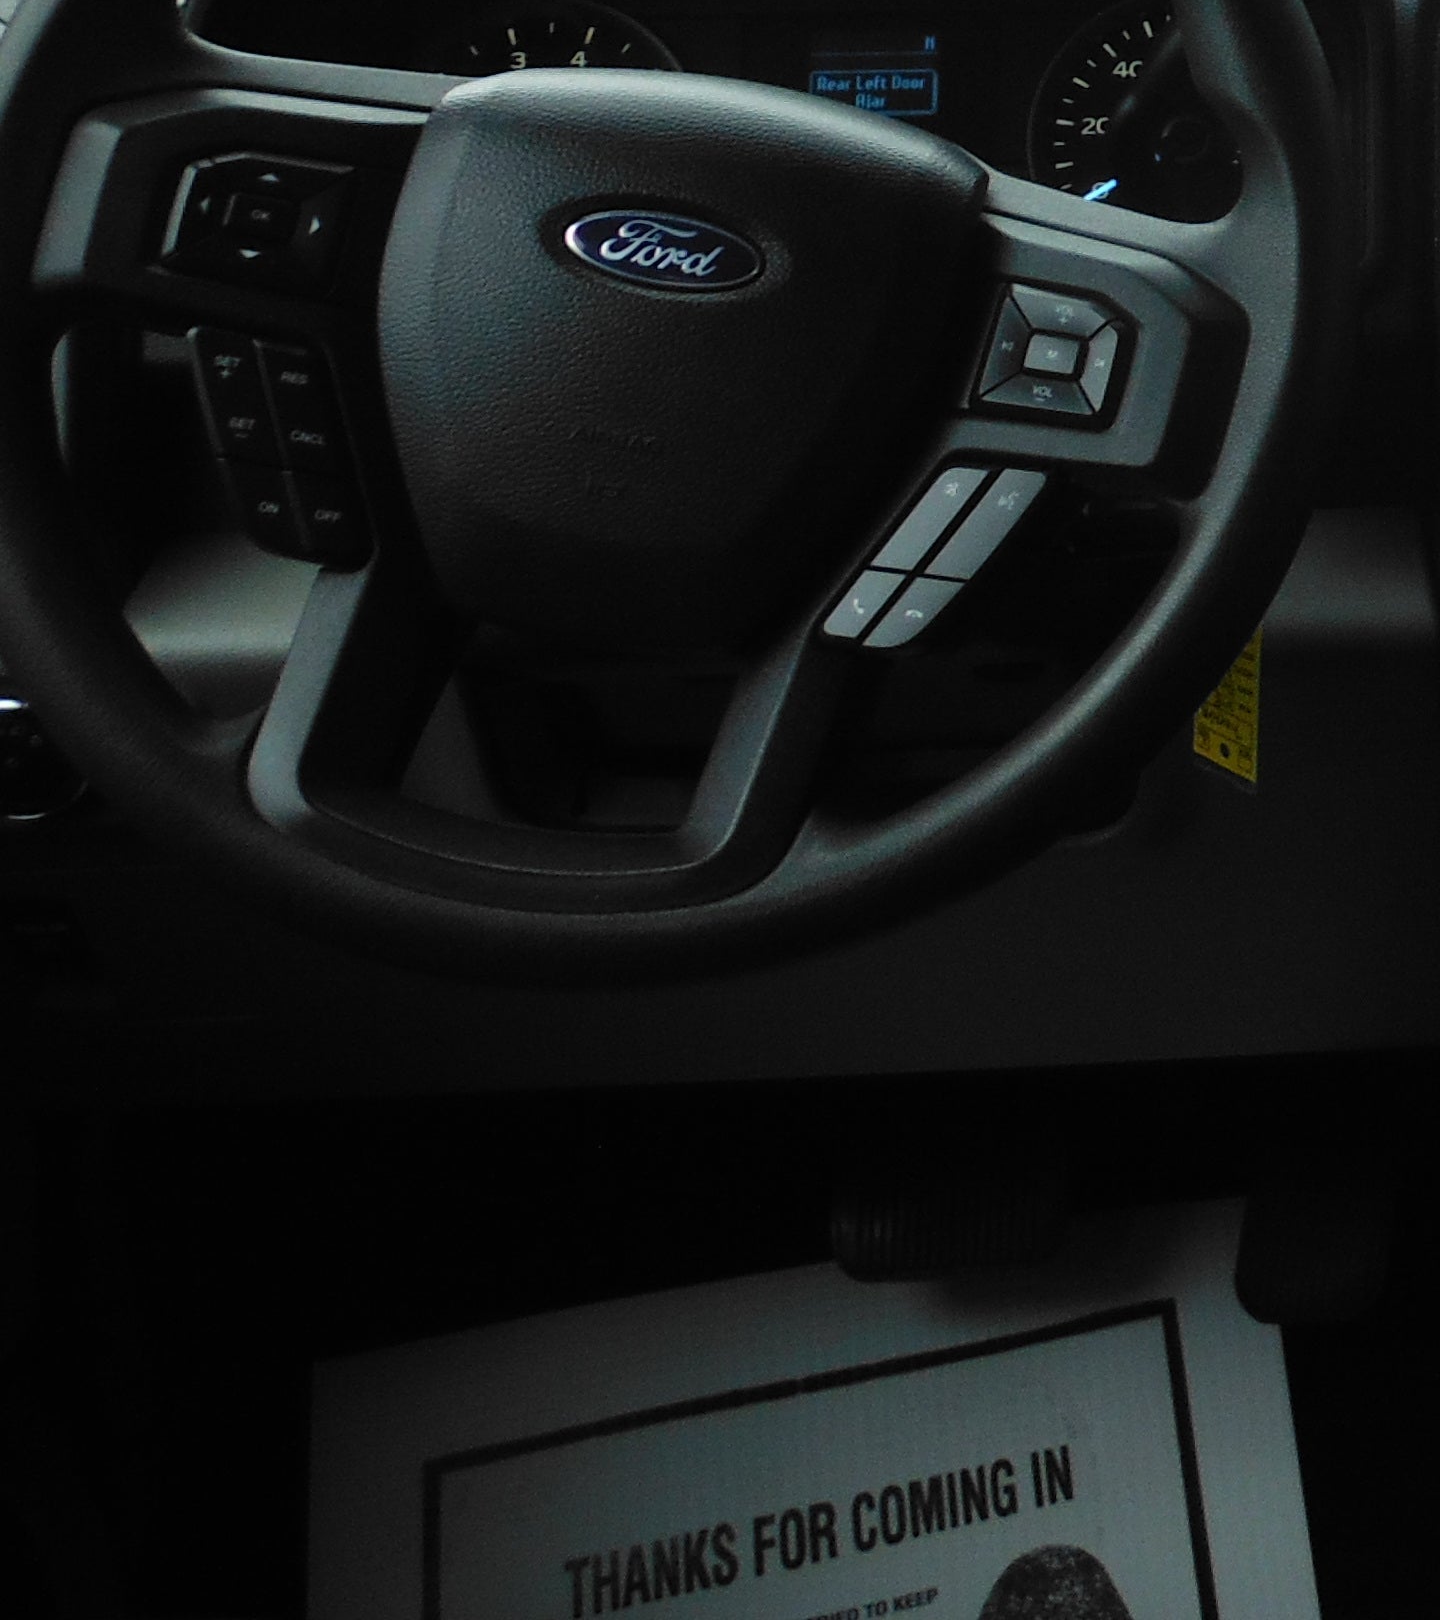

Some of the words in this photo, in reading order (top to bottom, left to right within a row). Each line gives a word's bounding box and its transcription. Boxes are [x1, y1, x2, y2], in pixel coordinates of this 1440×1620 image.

[509, 51, 527, 70] 3
[569, 50, 588, 68] 4
[816, 74, 851, 91] Rear
[856, 74, 888, 91] Left
[891, 74, 925, 90] Door
[855, 92, 888, 111] Ajar
[252, 208, 271, 221] OK
[599, 218, 725, 277] Ford
[1032, 384, 1053, 398] VOL
[256, 501, 280, 514] ON
[314, 509, 343, 523] OFF
[565, 1523, 739, 1619] THANKS
[752, 1501, 838, 1577] FOR
[852, 1457, 1018, 1553] COMING
[1030, 1443, 1075, 1508] IN
[863, 1600, 888, 1619] TO
[892, 1586, 939, 1612] KEEP
